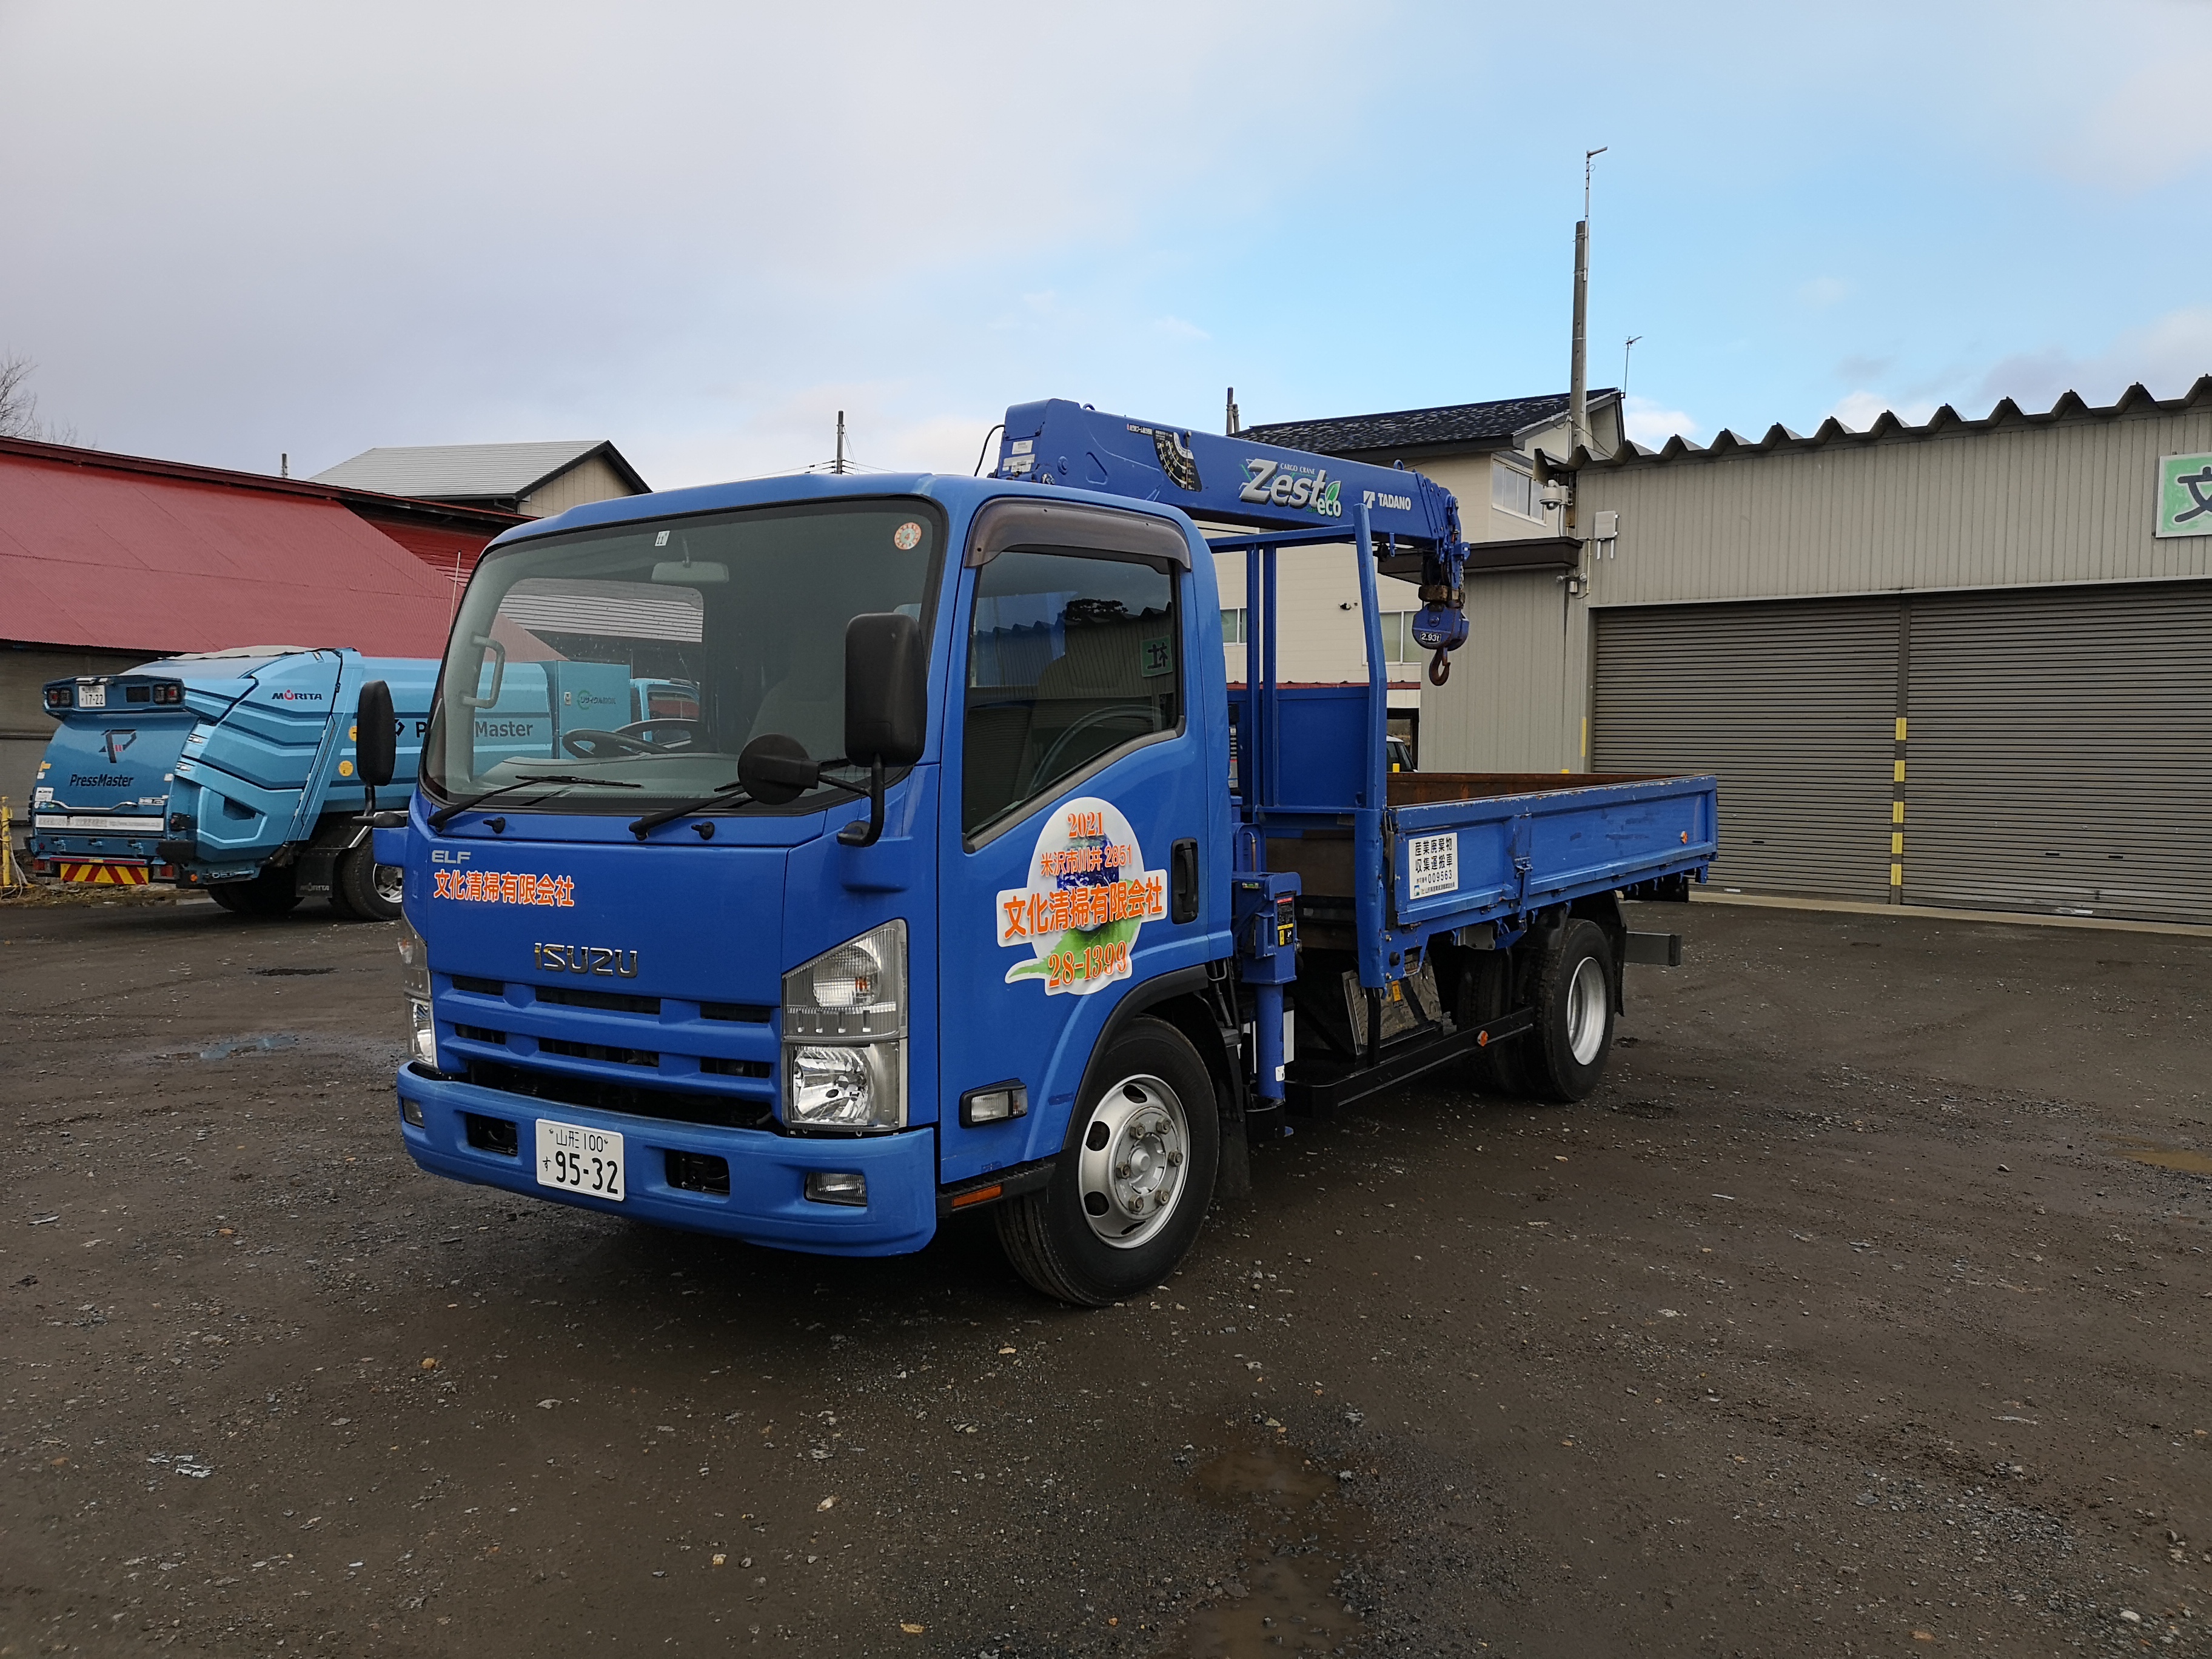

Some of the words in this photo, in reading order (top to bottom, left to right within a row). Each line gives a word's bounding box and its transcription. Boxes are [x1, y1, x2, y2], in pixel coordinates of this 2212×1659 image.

[1280, 463, 1298, 472] CARGO
[1299, 466, 1315, 475] CRANE
[1239, 458, 1328, 509] Zest
[1317, 498, 1342, 517] eco
[1378, 492, 1412, 511] TADANO
[1421, 633, 1440, 642] 2.93t
[271, 689, 323, 700] MORITA
[70, 774, 134, 787] PressMaster
[1067, 811, 1105, 838] 2021
[1415, 837, 1452, 856] 産業廃棄物
[432, 850, 471, 864] ELF
[1041, 846, 1102, 877] 米沢市川井
[1105, 843, 1133, 867] 2851
[1415, 853, 1453, 873] 収集運搬車
[1428, 870, 1452, 883] 009563
[434, 868, 575, 907] 文化清掃有限会社
[1003, 876, 1163, 940] 文化清掃有限会社
[534, 942, 638, 978] ISUZU
[1048, 940, 1127, 988] 28-1399
[556, 1129, 580, 1148] 山形
[585, 1133, 603, 1152] 100
[542, 1156, 551, 1171] す
[555, 1151, 618, 1195] 95-32
